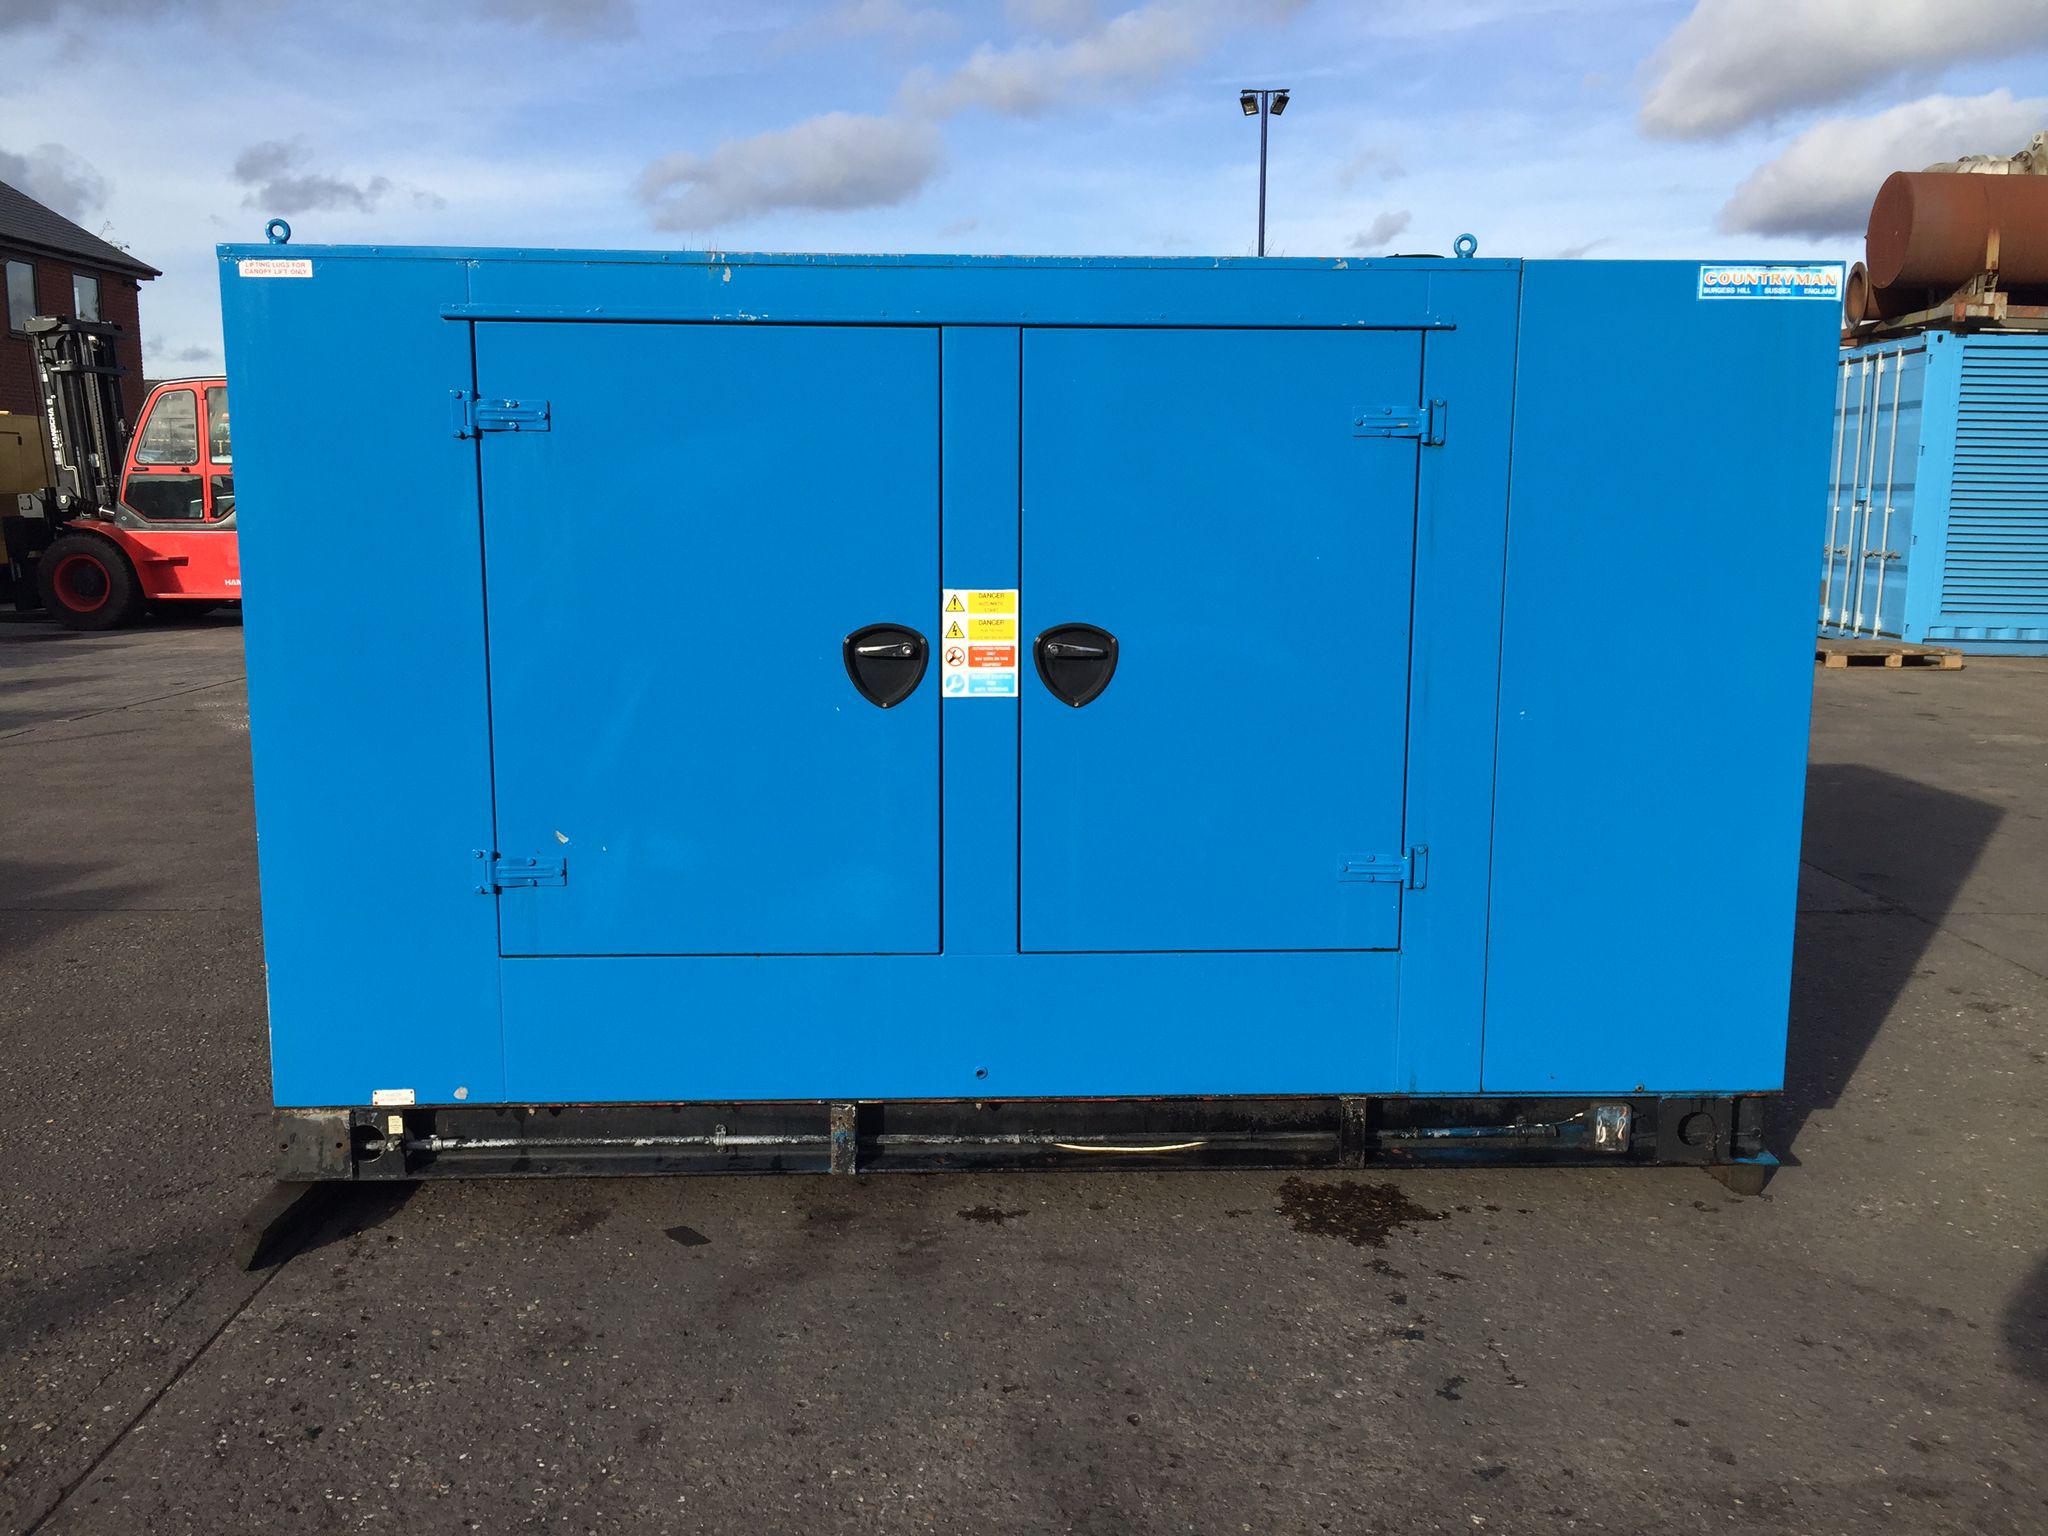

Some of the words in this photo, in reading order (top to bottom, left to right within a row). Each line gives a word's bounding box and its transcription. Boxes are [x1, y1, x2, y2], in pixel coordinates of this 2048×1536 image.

[1705, 272, 1837, 285] COUNTRYMAN
[1803, 287, 1835, 295] ENGLAND
[47, 407, 59, 449] HANGCHA
